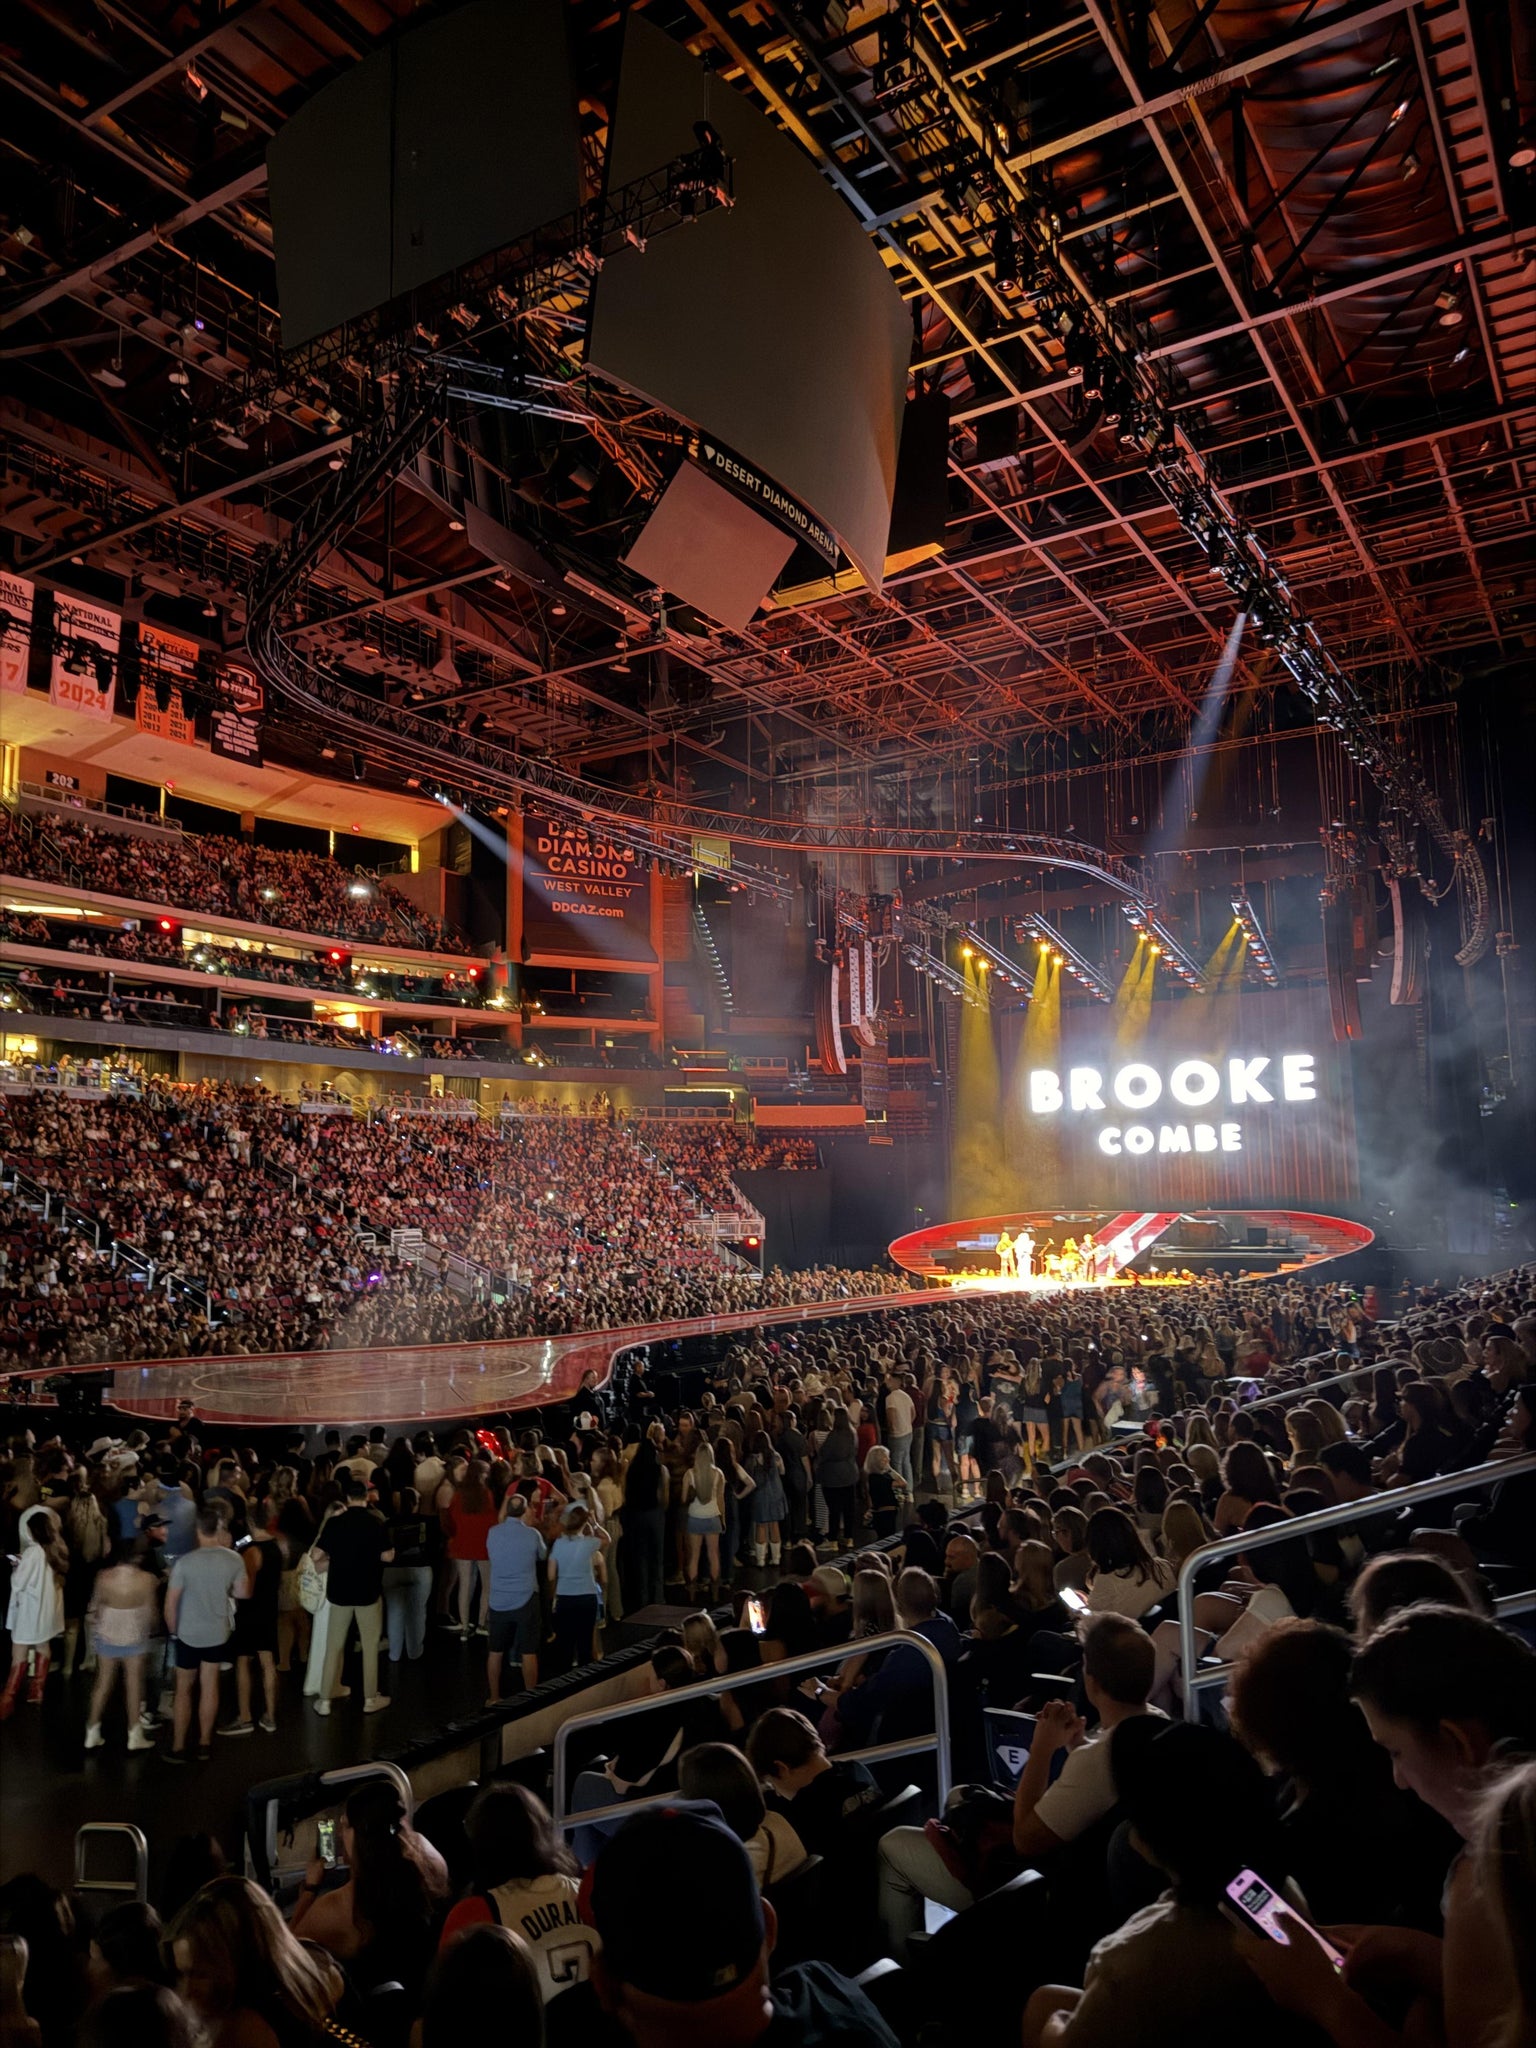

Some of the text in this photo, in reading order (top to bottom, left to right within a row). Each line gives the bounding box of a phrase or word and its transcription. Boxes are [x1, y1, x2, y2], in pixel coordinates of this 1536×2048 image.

[715, 452, 834, 556] DESERT DIAMOND ARENA
[59, 679, 107, 711] 2024
[51, 772, 74, 789] 202
[547, 857, 628, 879] CASINO
[543, 879, 632, 899] WEST VALLEY
[551, 901, 625, 919] DDCAZ.com
[1029, 1054, 1318, 1114] BROOKE
[1098, 1122, 1243, 1156] COMBE
